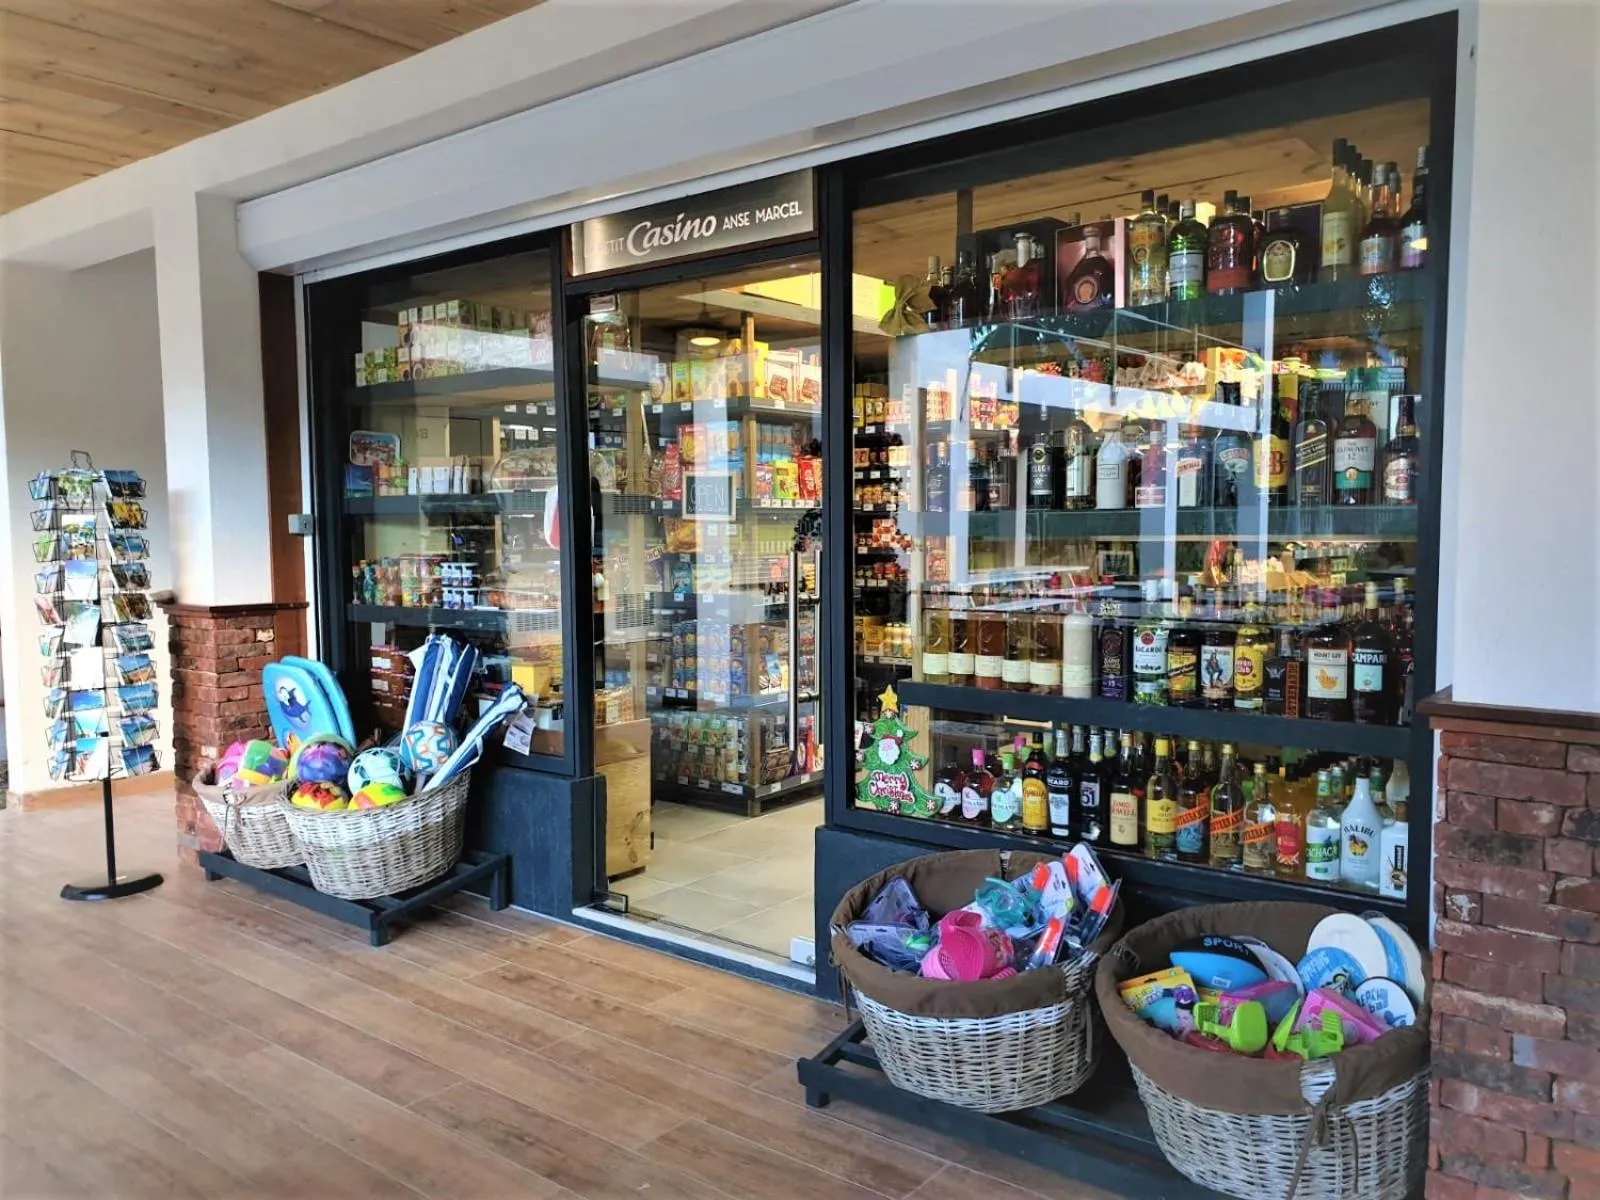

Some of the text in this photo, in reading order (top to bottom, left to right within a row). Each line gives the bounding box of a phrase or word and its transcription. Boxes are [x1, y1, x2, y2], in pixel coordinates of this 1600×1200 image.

[627, 213, 717, 256] Casino
[722, 211, 750, 231] ANSE
[755, 200, 803, 224] MARCEL
[690, 484, 725, 506] OPEN
[1083, 789, 1096, 805] 51
[1343, 824, 1374, 838] MALIBU
